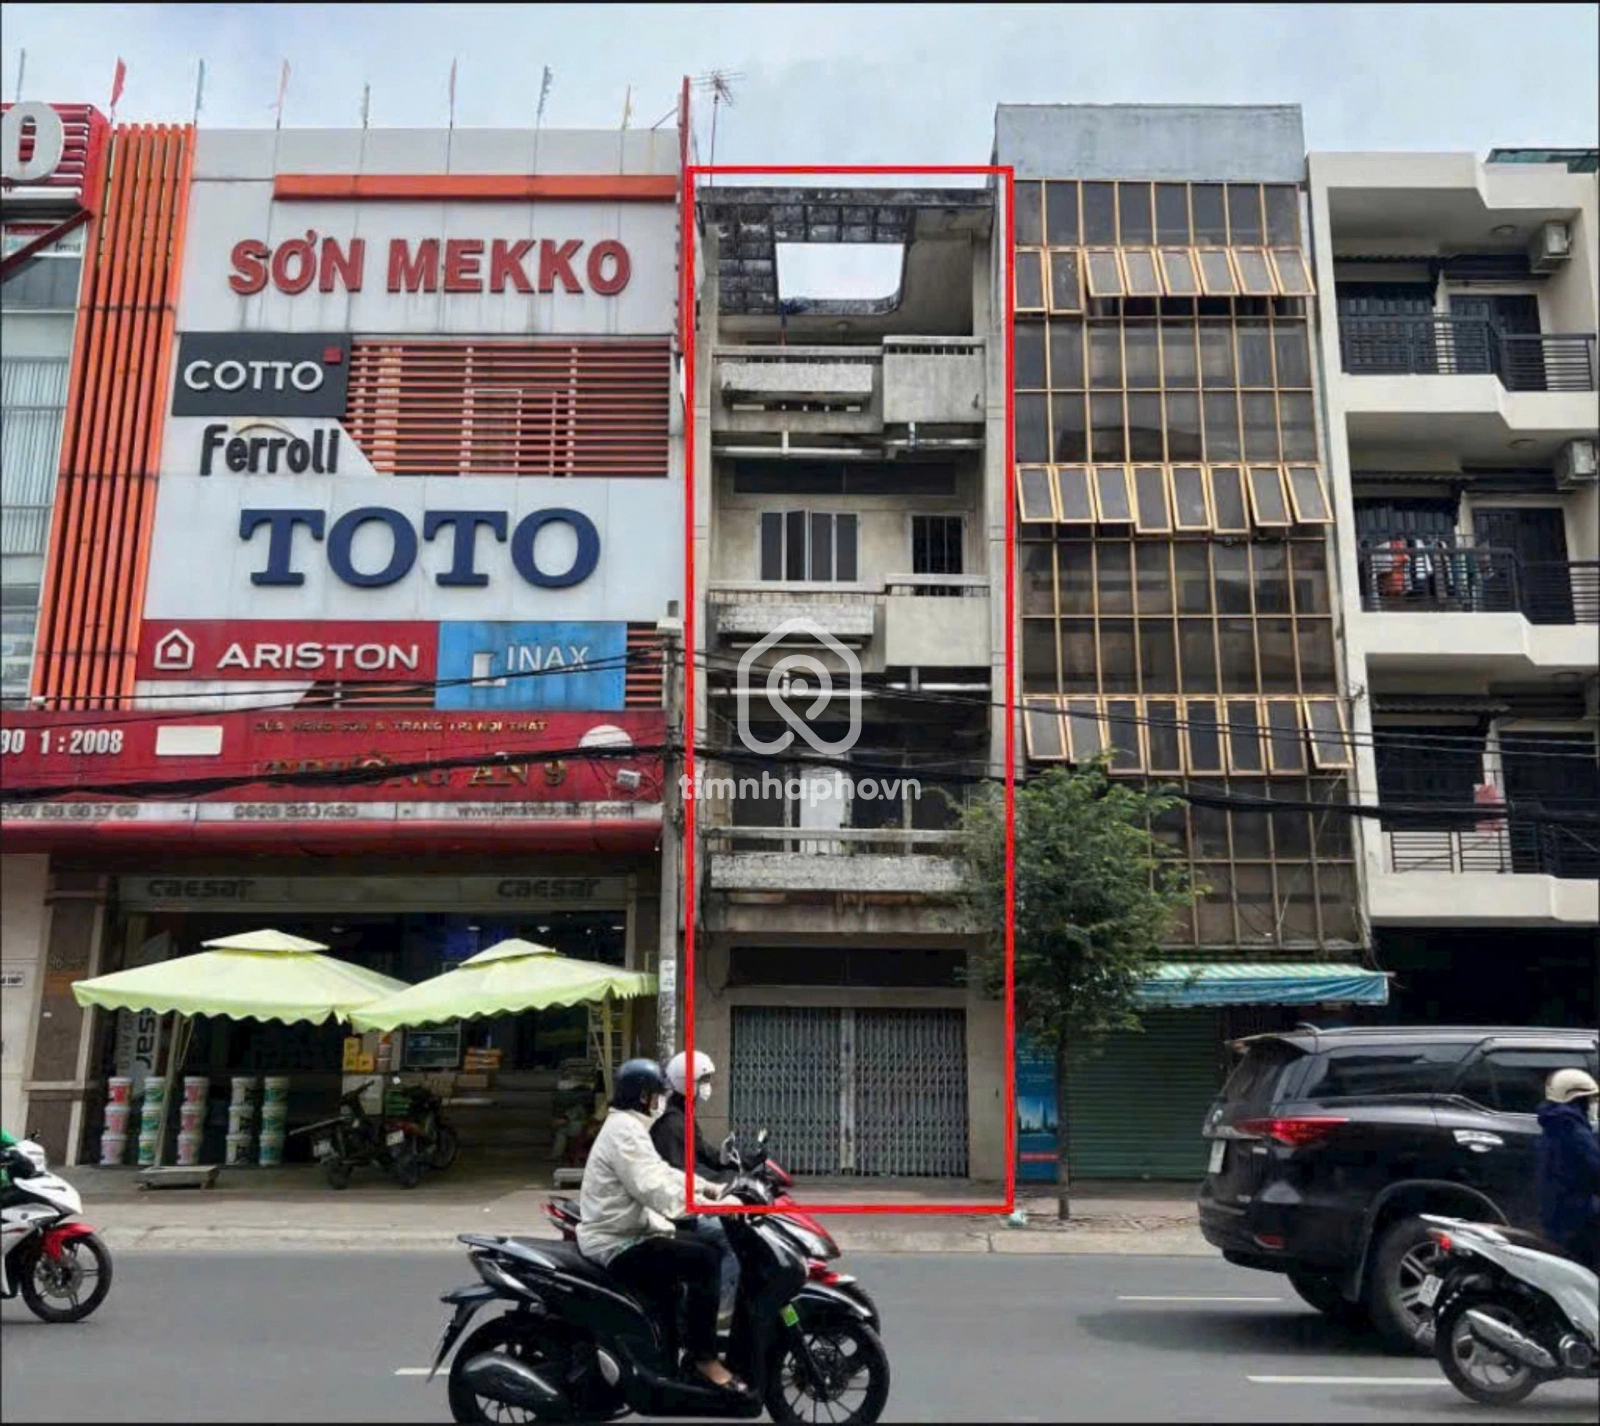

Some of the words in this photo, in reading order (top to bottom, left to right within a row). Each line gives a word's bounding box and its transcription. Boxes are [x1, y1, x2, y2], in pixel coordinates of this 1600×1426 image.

[228, 229, 365, 296] SƠN
[387, 238, 631, 296] MEKKO
[183, 359, 324, 393] COTTO
[239, 507, 600, 588] TOTO
[216, 644, 419, 671] ARISTON
[507, 646, 590, 671] INAX
